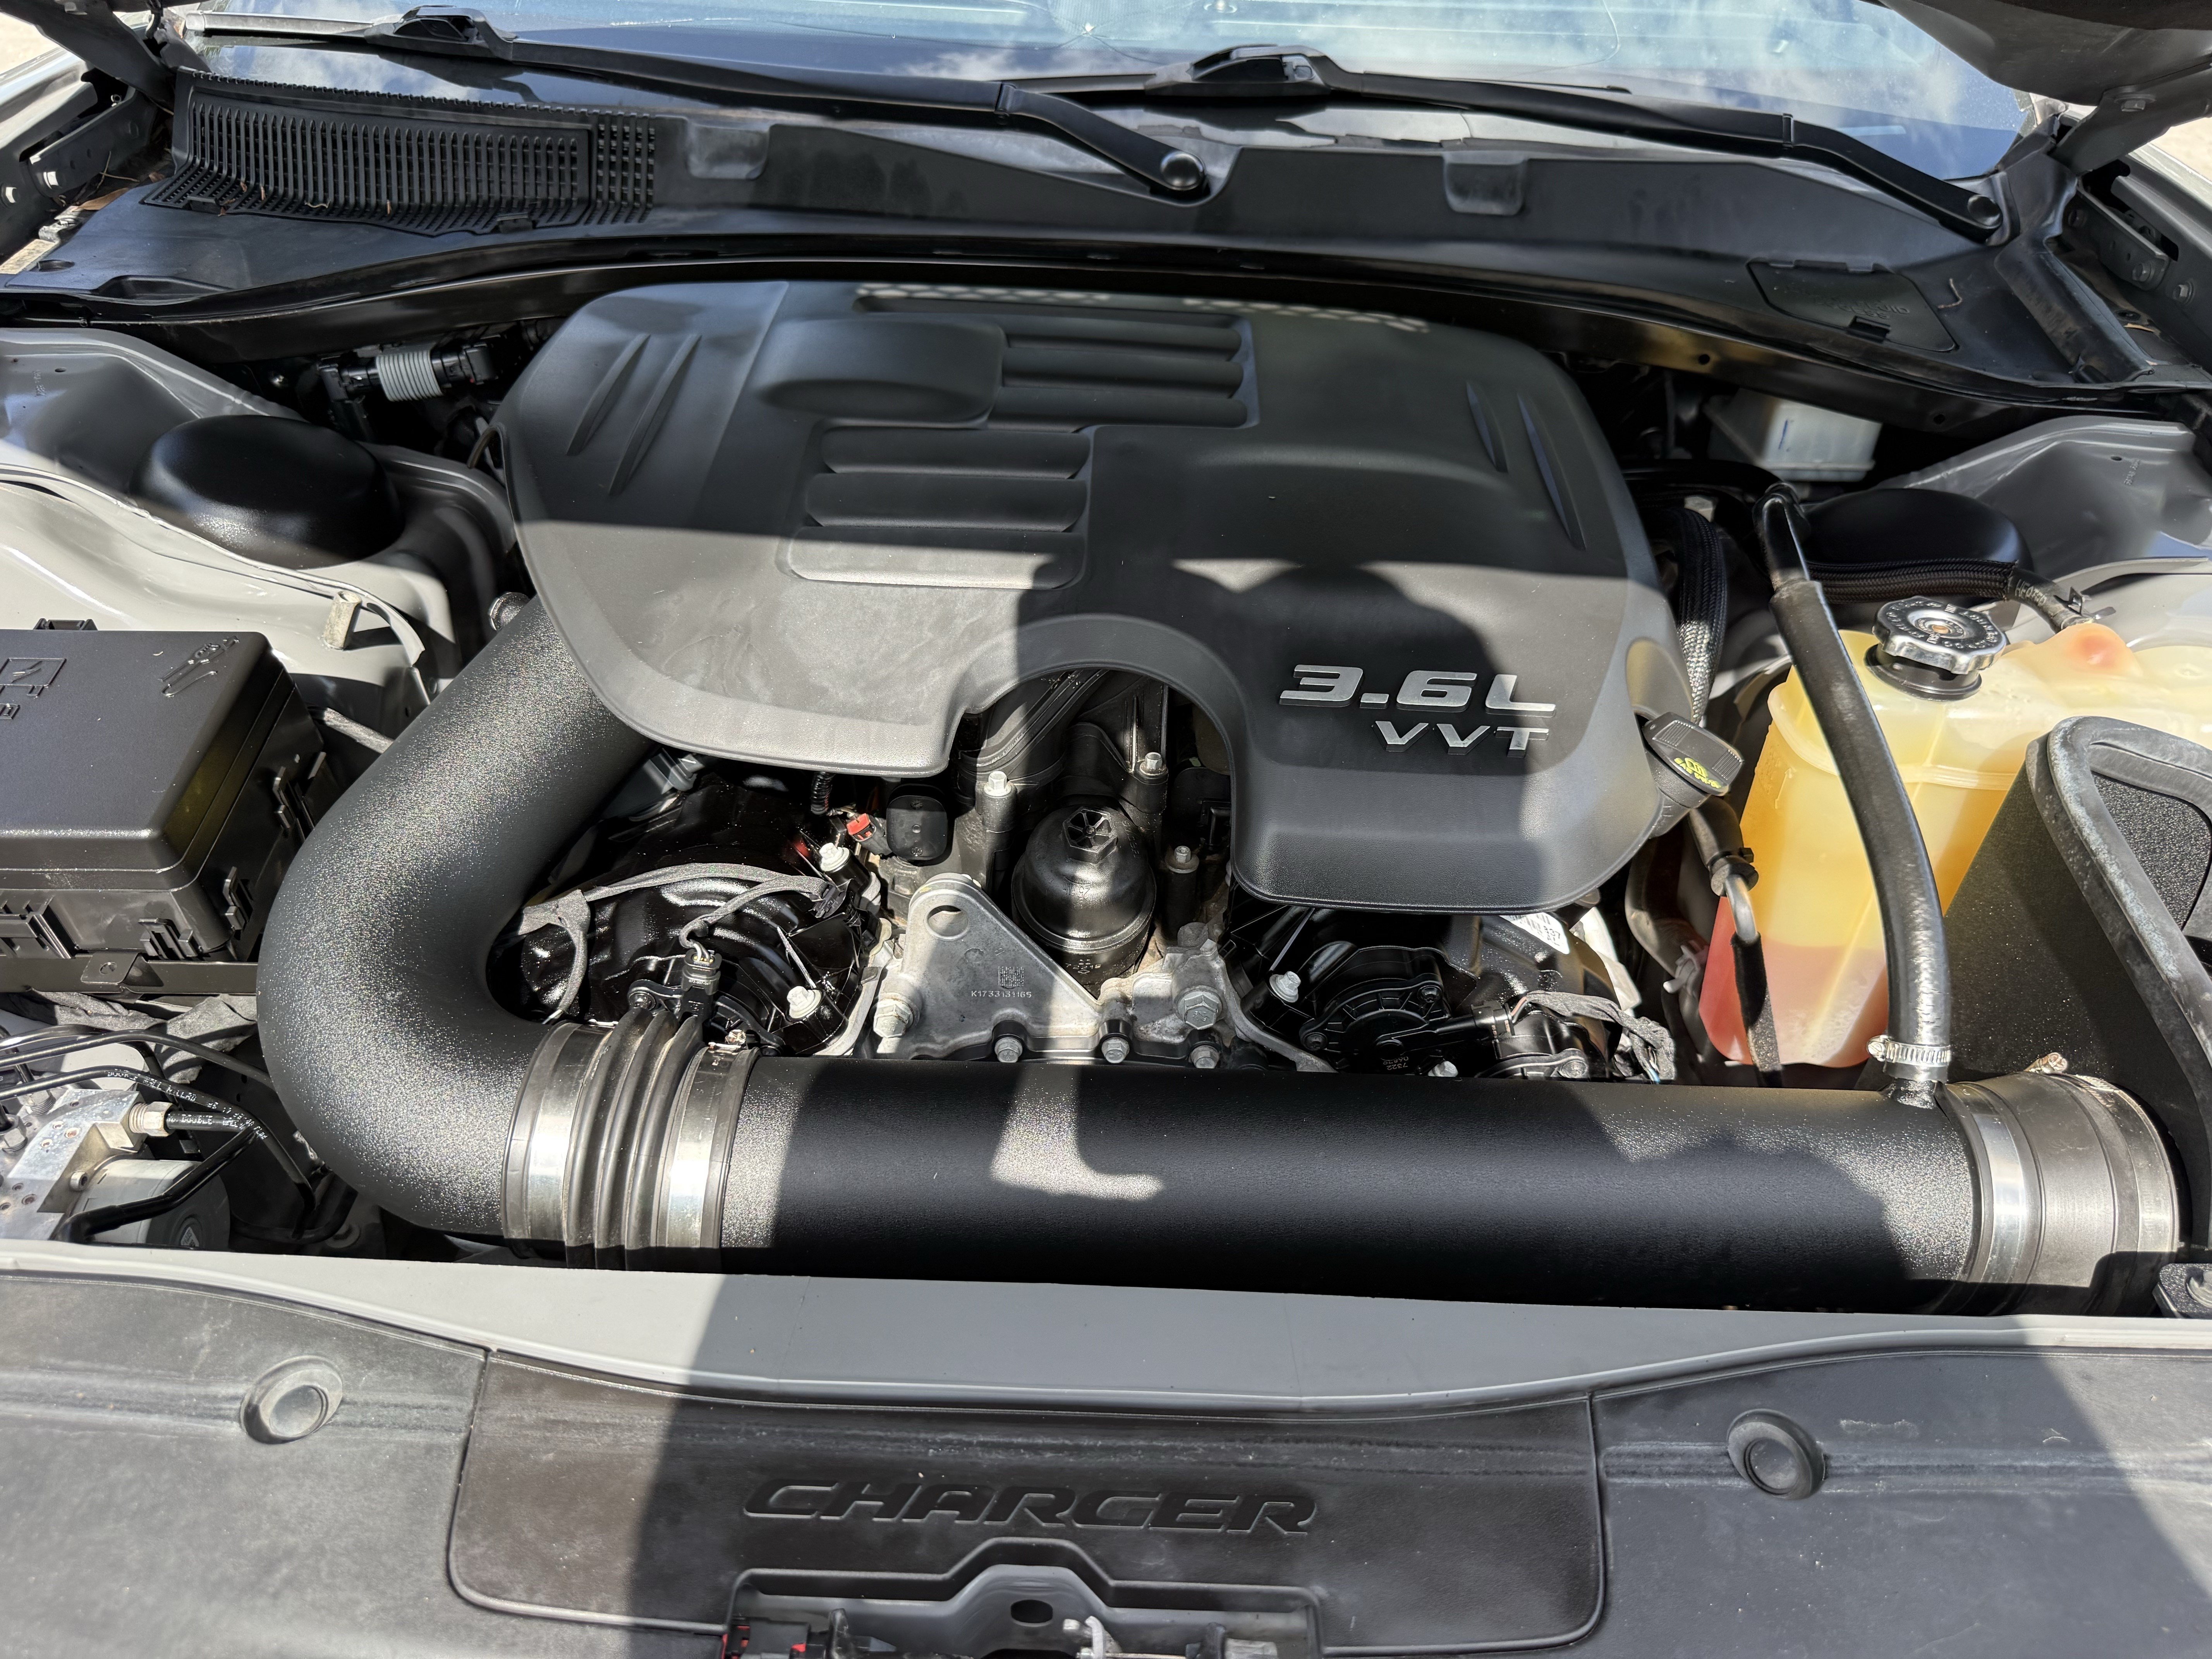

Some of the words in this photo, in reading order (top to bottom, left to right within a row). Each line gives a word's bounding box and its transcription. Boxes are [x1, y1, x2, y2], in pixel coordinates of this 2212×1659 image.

[1279, 665, 1556, 717] 3.6L
[1372, 721, 1549, 757] VVT
[743, 1477, 1318, 1535] CHARGER
